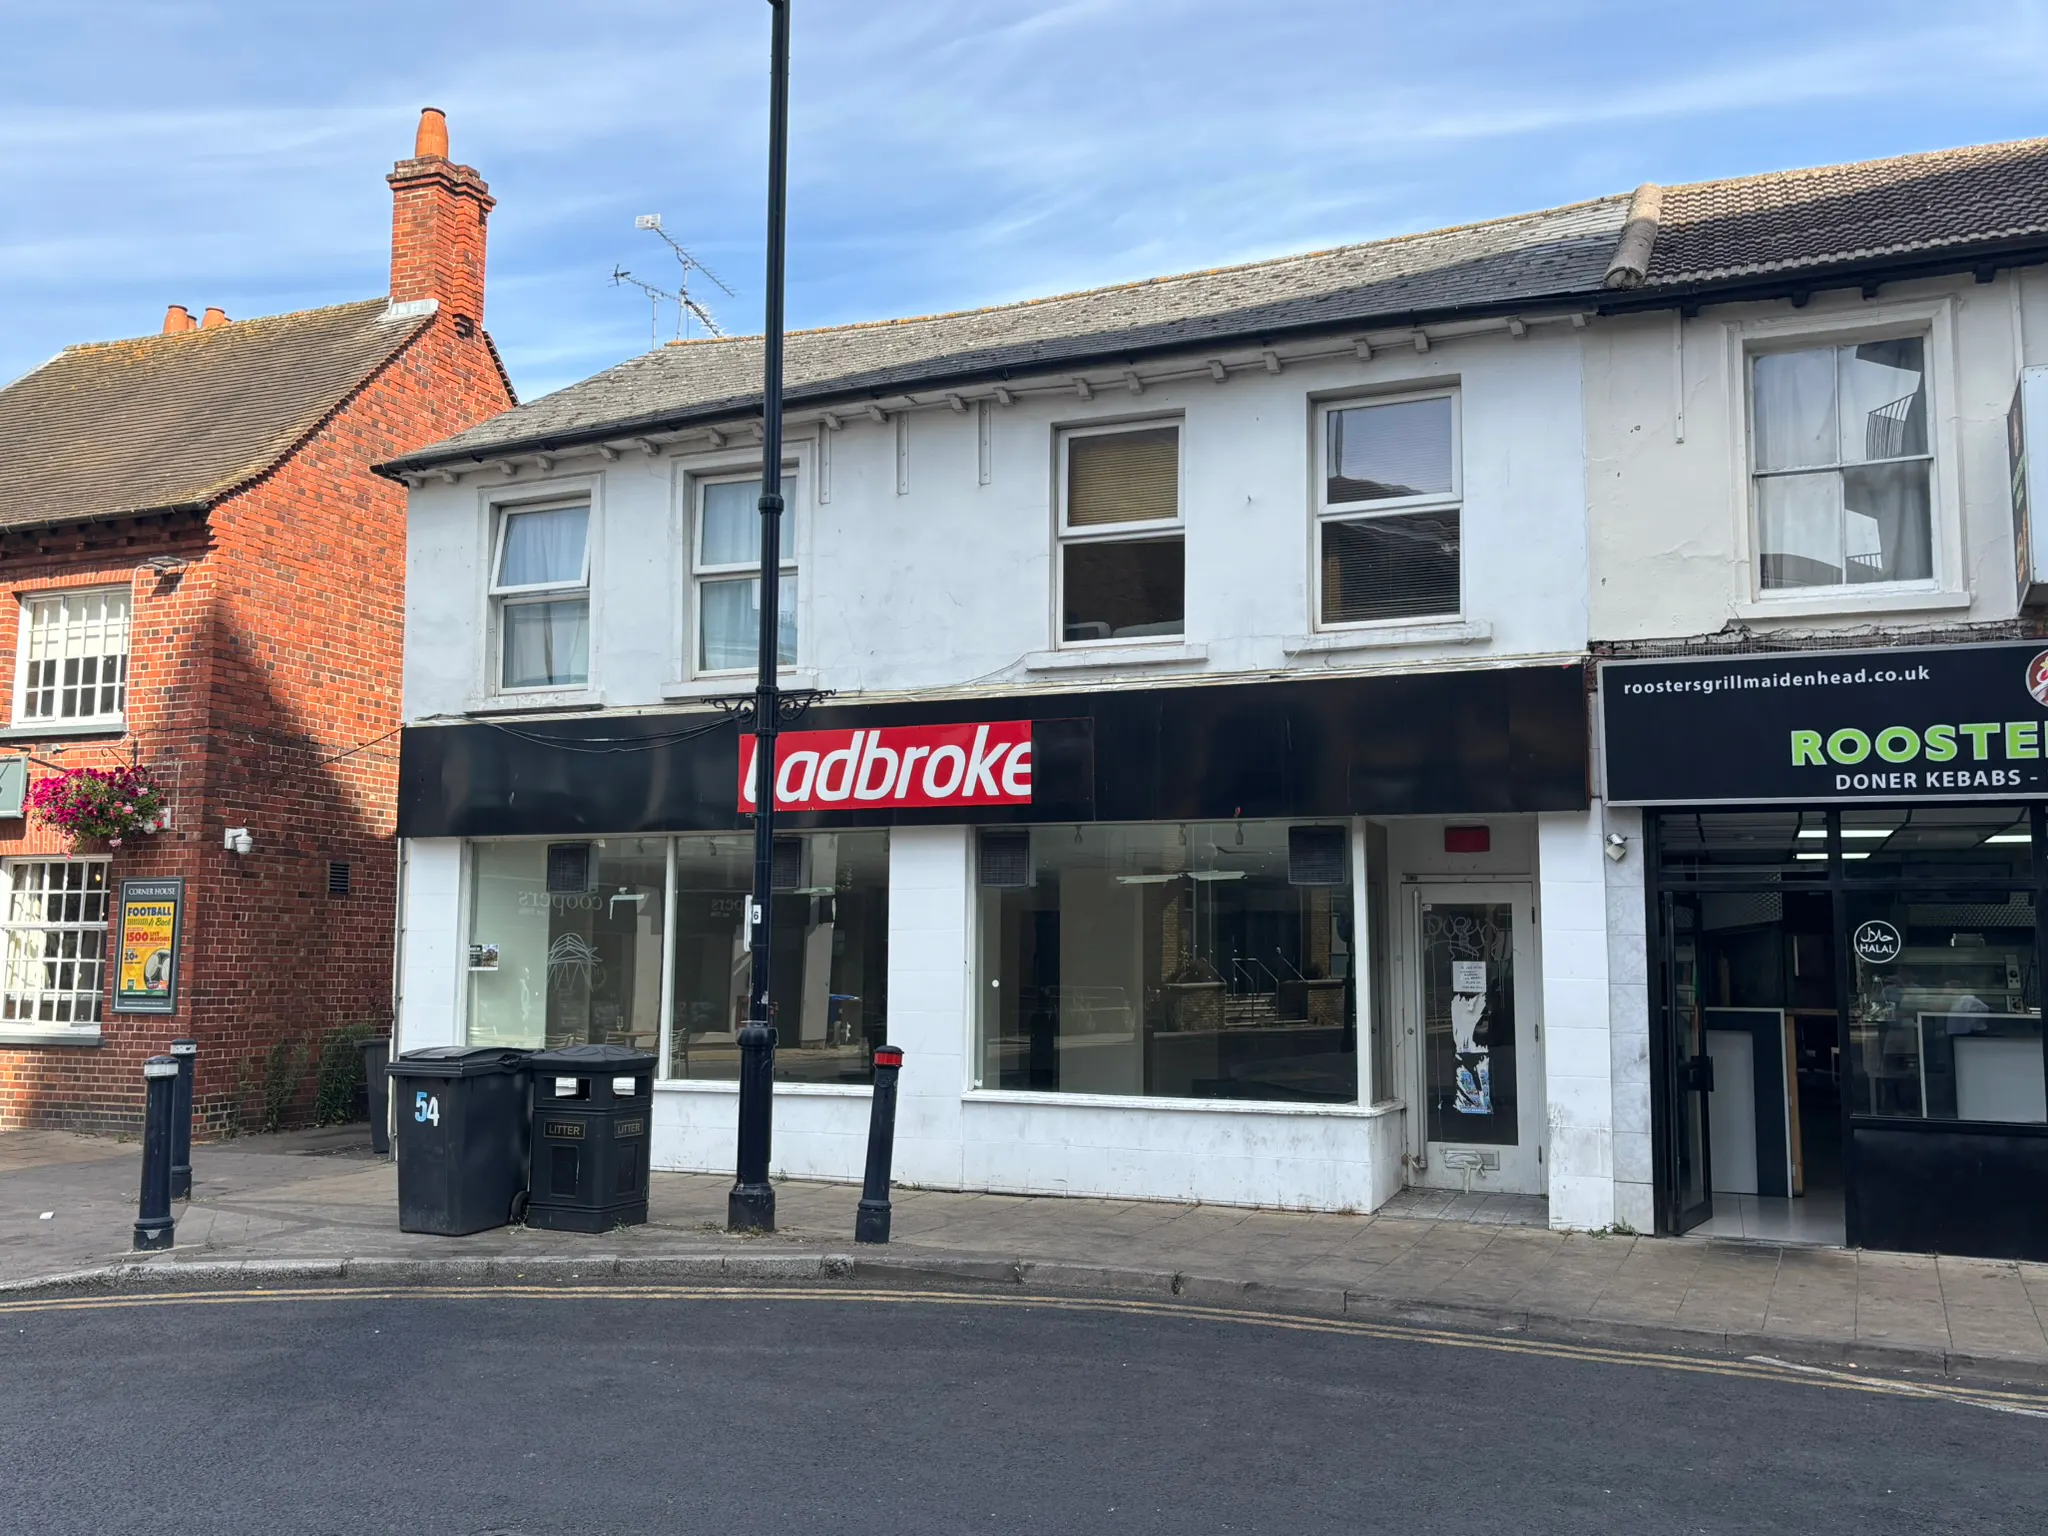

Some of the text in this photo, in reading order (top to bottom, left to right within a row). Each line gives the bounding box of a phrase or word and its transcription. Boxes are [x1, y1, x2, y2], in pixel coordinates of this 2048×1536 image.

[1624, 665, 1930, 694] roostersgrillmaidenhead.co.uk
[1791, 721, 2048, 766] ROOSTE
[1835, 772, 1917, 790] DONER
[1926, 769, 2021, 788] KEBABS
[128, 887, 176, 896] CORNER HOUSE
[127, 906, 172, 917] FOOTBALL
[126, 931, 149, 942] 1500
[1860, 926, 1894, 943] حلال
[1860, 943, 1895, 954] HALAL
[415, 1091, 440, 1127] 54
[549, 1123, 580, 1136] LITTER
[617, 1123, 641, 1134] LITTER
